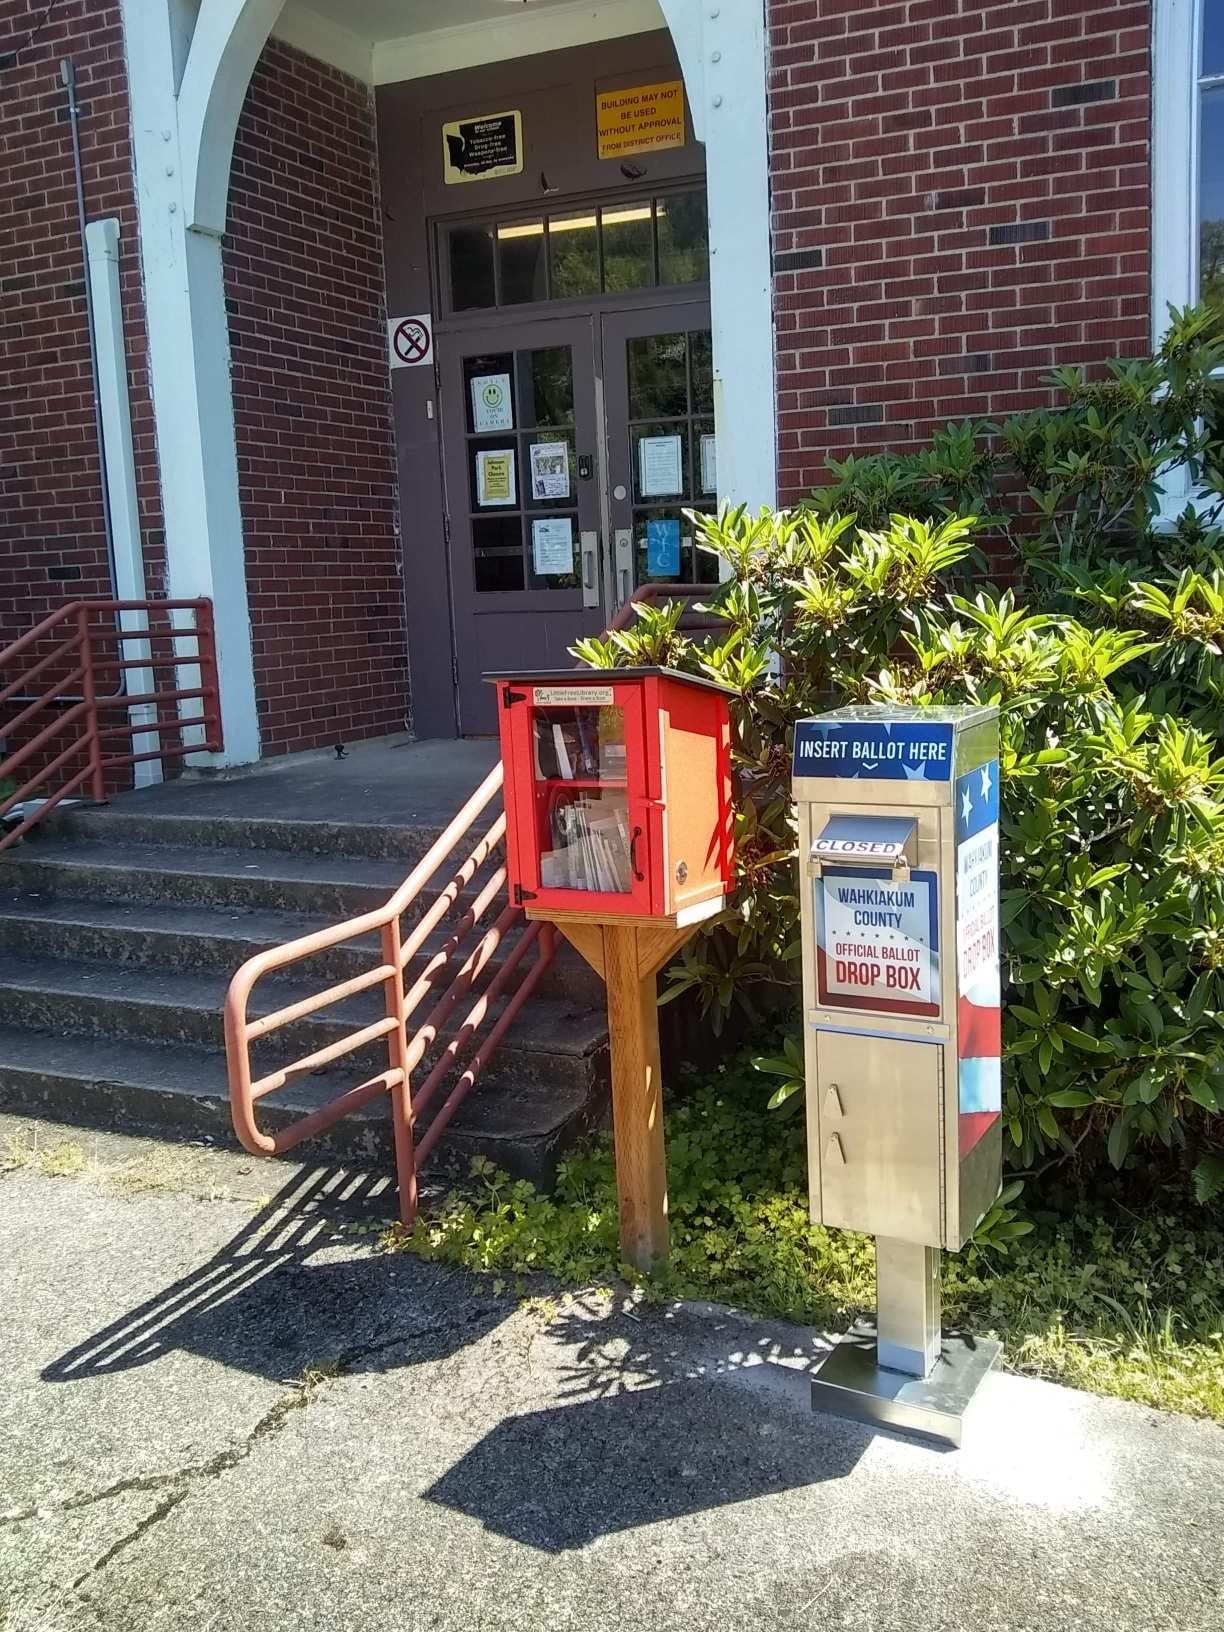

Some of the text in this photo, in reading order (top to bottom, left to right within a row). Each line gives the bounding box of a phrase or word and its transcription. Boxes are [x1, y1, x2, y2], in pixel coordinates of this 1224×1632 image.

[601, 89, 677, 110] BUILDING MAY NOT
[620, 107, 656, 120] BE USED
[474, 121, 502, 130] Welcome
[599, 117, 681, 137] WITHOUT APPROVAL
[474, 141, 501, 150] Drug-free
[602, 132, 681, 151] FROM DISTRICT OFFICE
[800, 740, 947, 761] INSERT BALLOT HERE
[816, 840, 896, 854] CLOSED
[838, 888, 915, 908] WAHKIAKUM
[854, 910, 902, 928] COUNTY
[835, 942, 920, 962] OFFICIAL BALLOT
[963, 927, 995, 979] DROP BOX
[835, 960, 921, 991] DROP BOX
